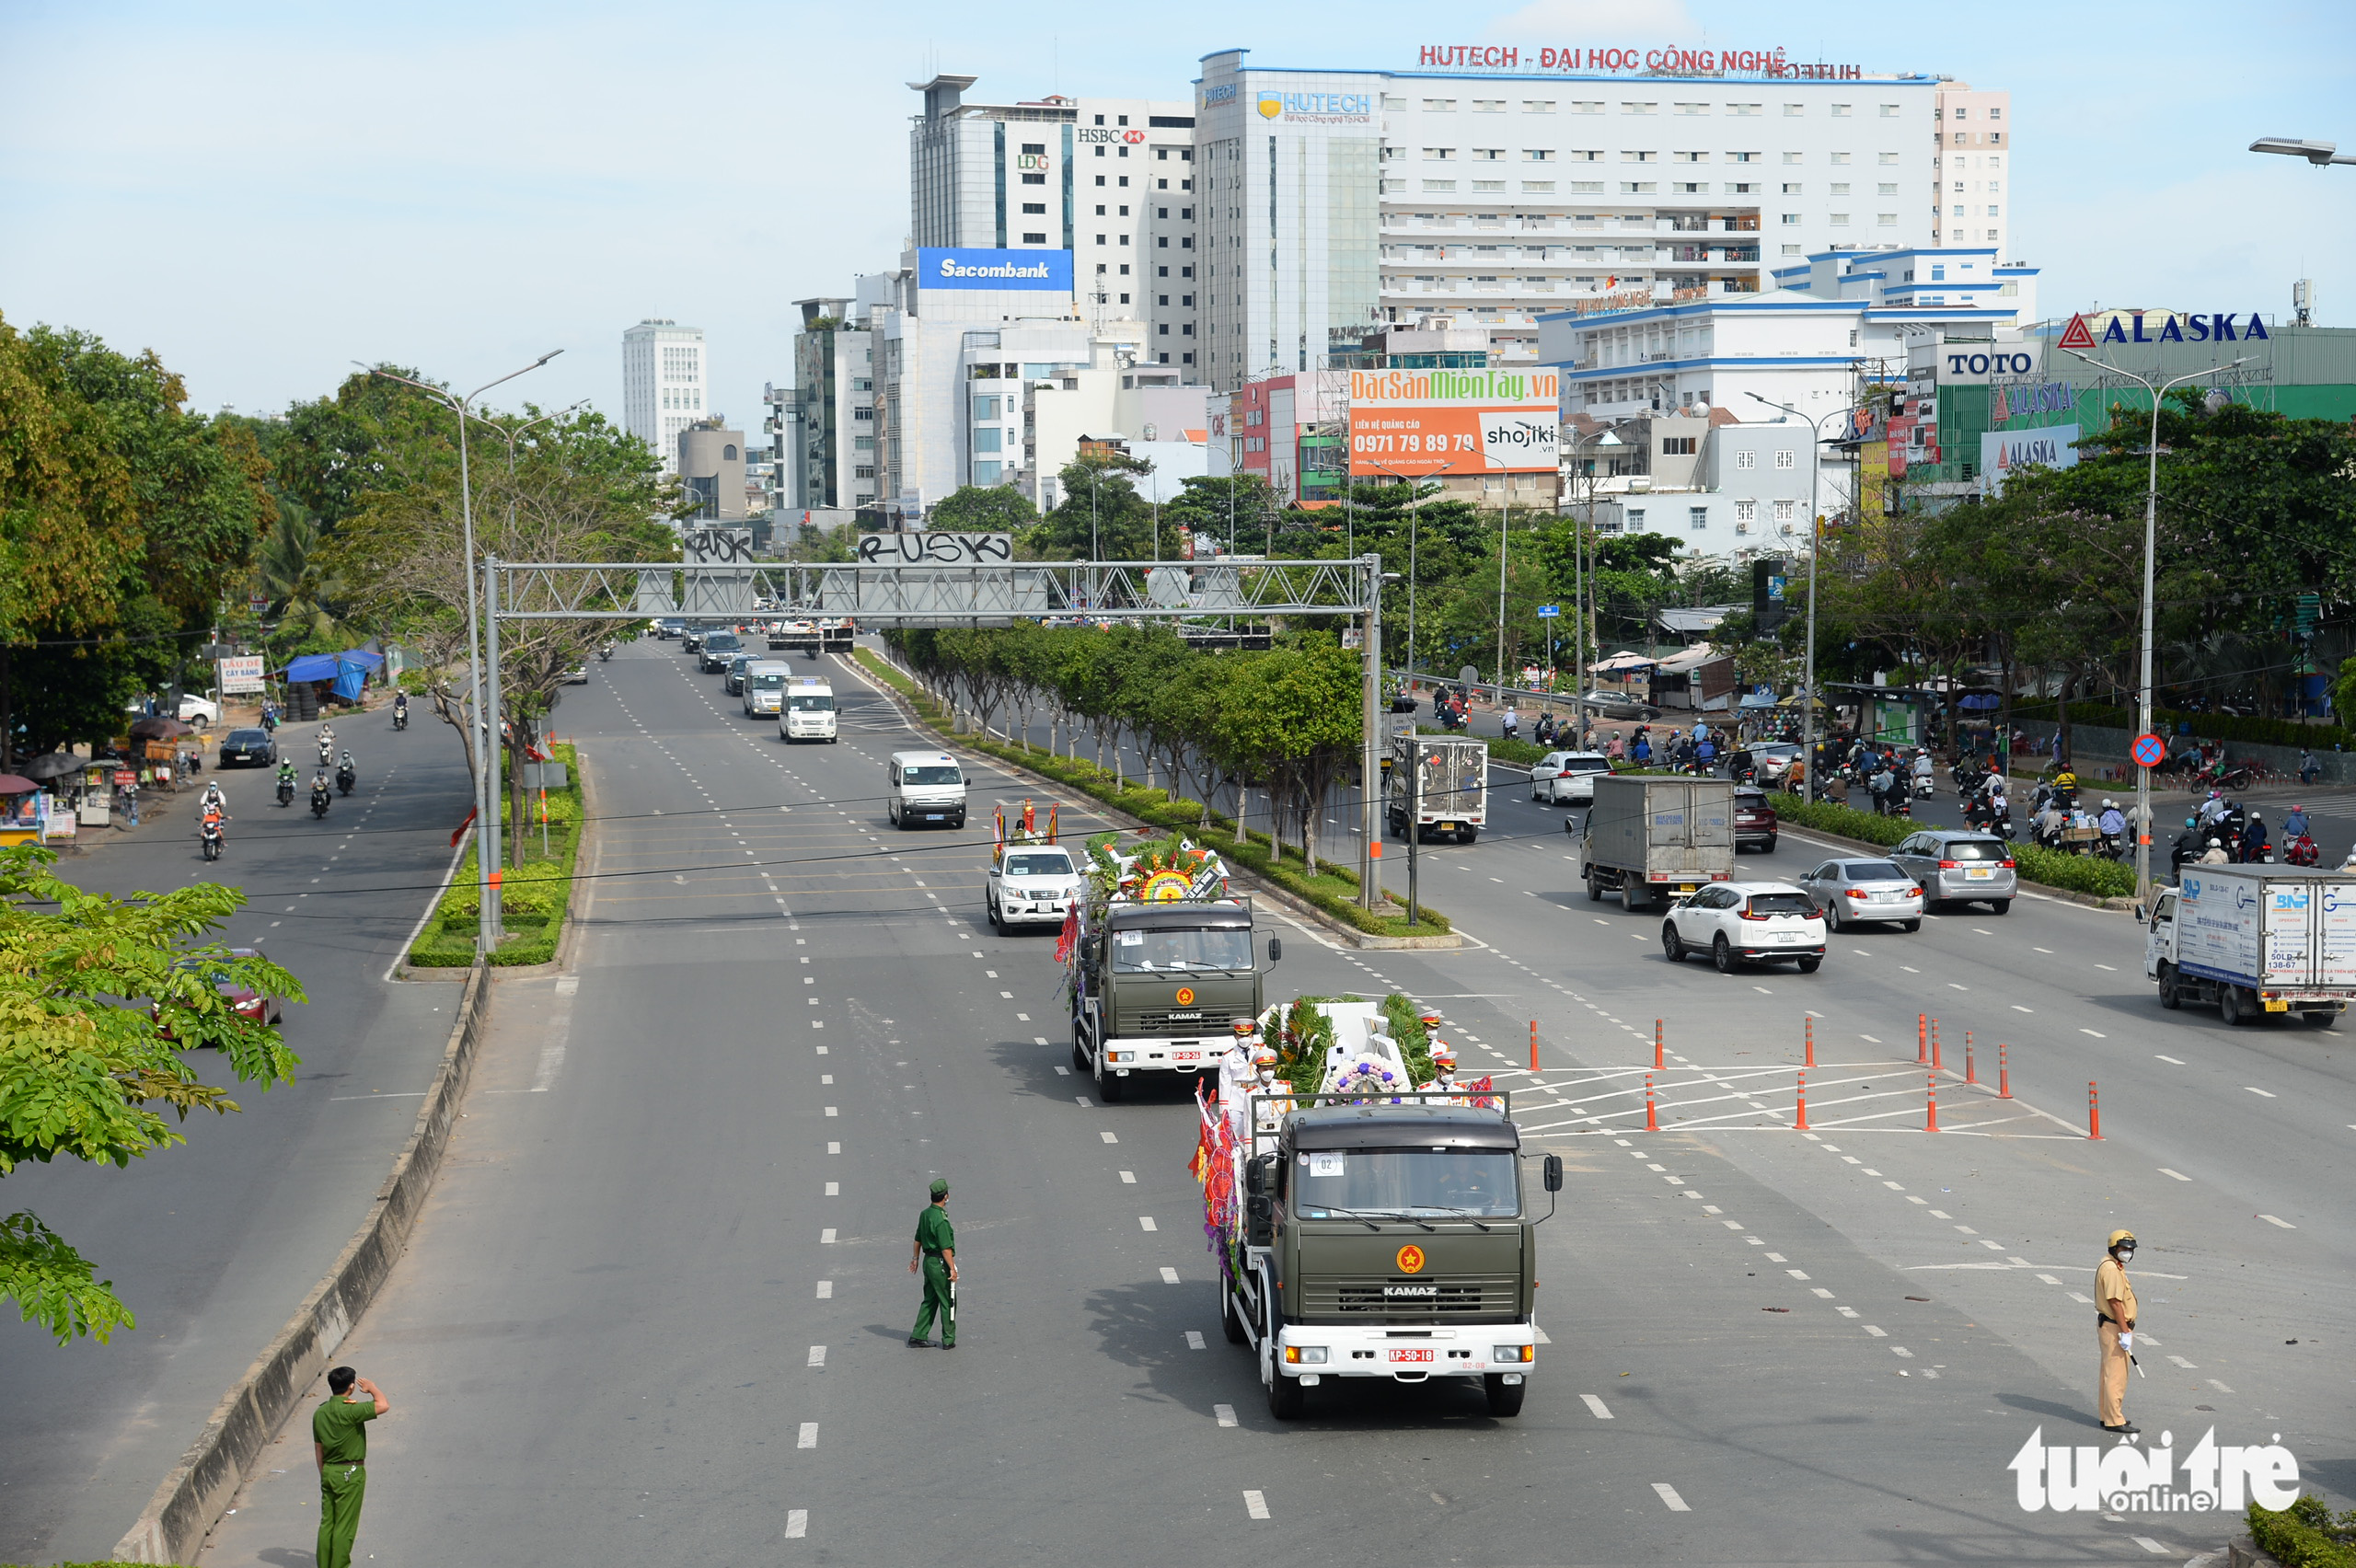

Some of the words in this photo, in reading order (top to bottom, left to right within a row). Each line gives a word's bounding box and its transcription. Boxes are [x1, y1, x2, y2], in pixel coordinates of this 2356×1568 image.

[1420, 45, 1518, 67] HUTECH
[1540, 48, 1580, 72] ĐẠI
[1588, 48, 1639, 73] HỌC
[1646, 44, 1715, 70] CÔNG
[1284, 93, 1371, 112] HUTECH
[1078, 129, 1120, 143] HSBC
[1018, 155, 1049, 169] LDG
[940, 259, 1049, 278] Sacombank
[2102, 312, 2269, 343] ALASKA
[1947, 353, 2031, 375] TOTO
[1351, 369, 1556, 403] ĐặcSảnMiềnTây.vn
[2011, 382, 2072, 415] ALASKA
[1356, 420, 1369, 430] LIÊN
[1371, 419, 1380, 431] HỆ
[1381, 419, 1404, 431] QUẢNG
[1405, 419, 1420, 430] CÁO
[1355, 434, 1393, 452] 0971
[1399, 434, 1420, 452] 79
[1426, 434, 1448, 452] 89
[1453, 434, 1474, 452] 79
[1487, 425, 1554, 448] shojiki
[2010, 439, 2057, 465] ALASKA
[860, 532, 1011, 563] RUSK
[2274, 894, 2309, 909] BNP
[1322, 1159, 1332, 1170] 02
[1384, 1287, 1437, 1296] KAMAZ
[1390, 1350, 1432, 1361] KP-50-18
